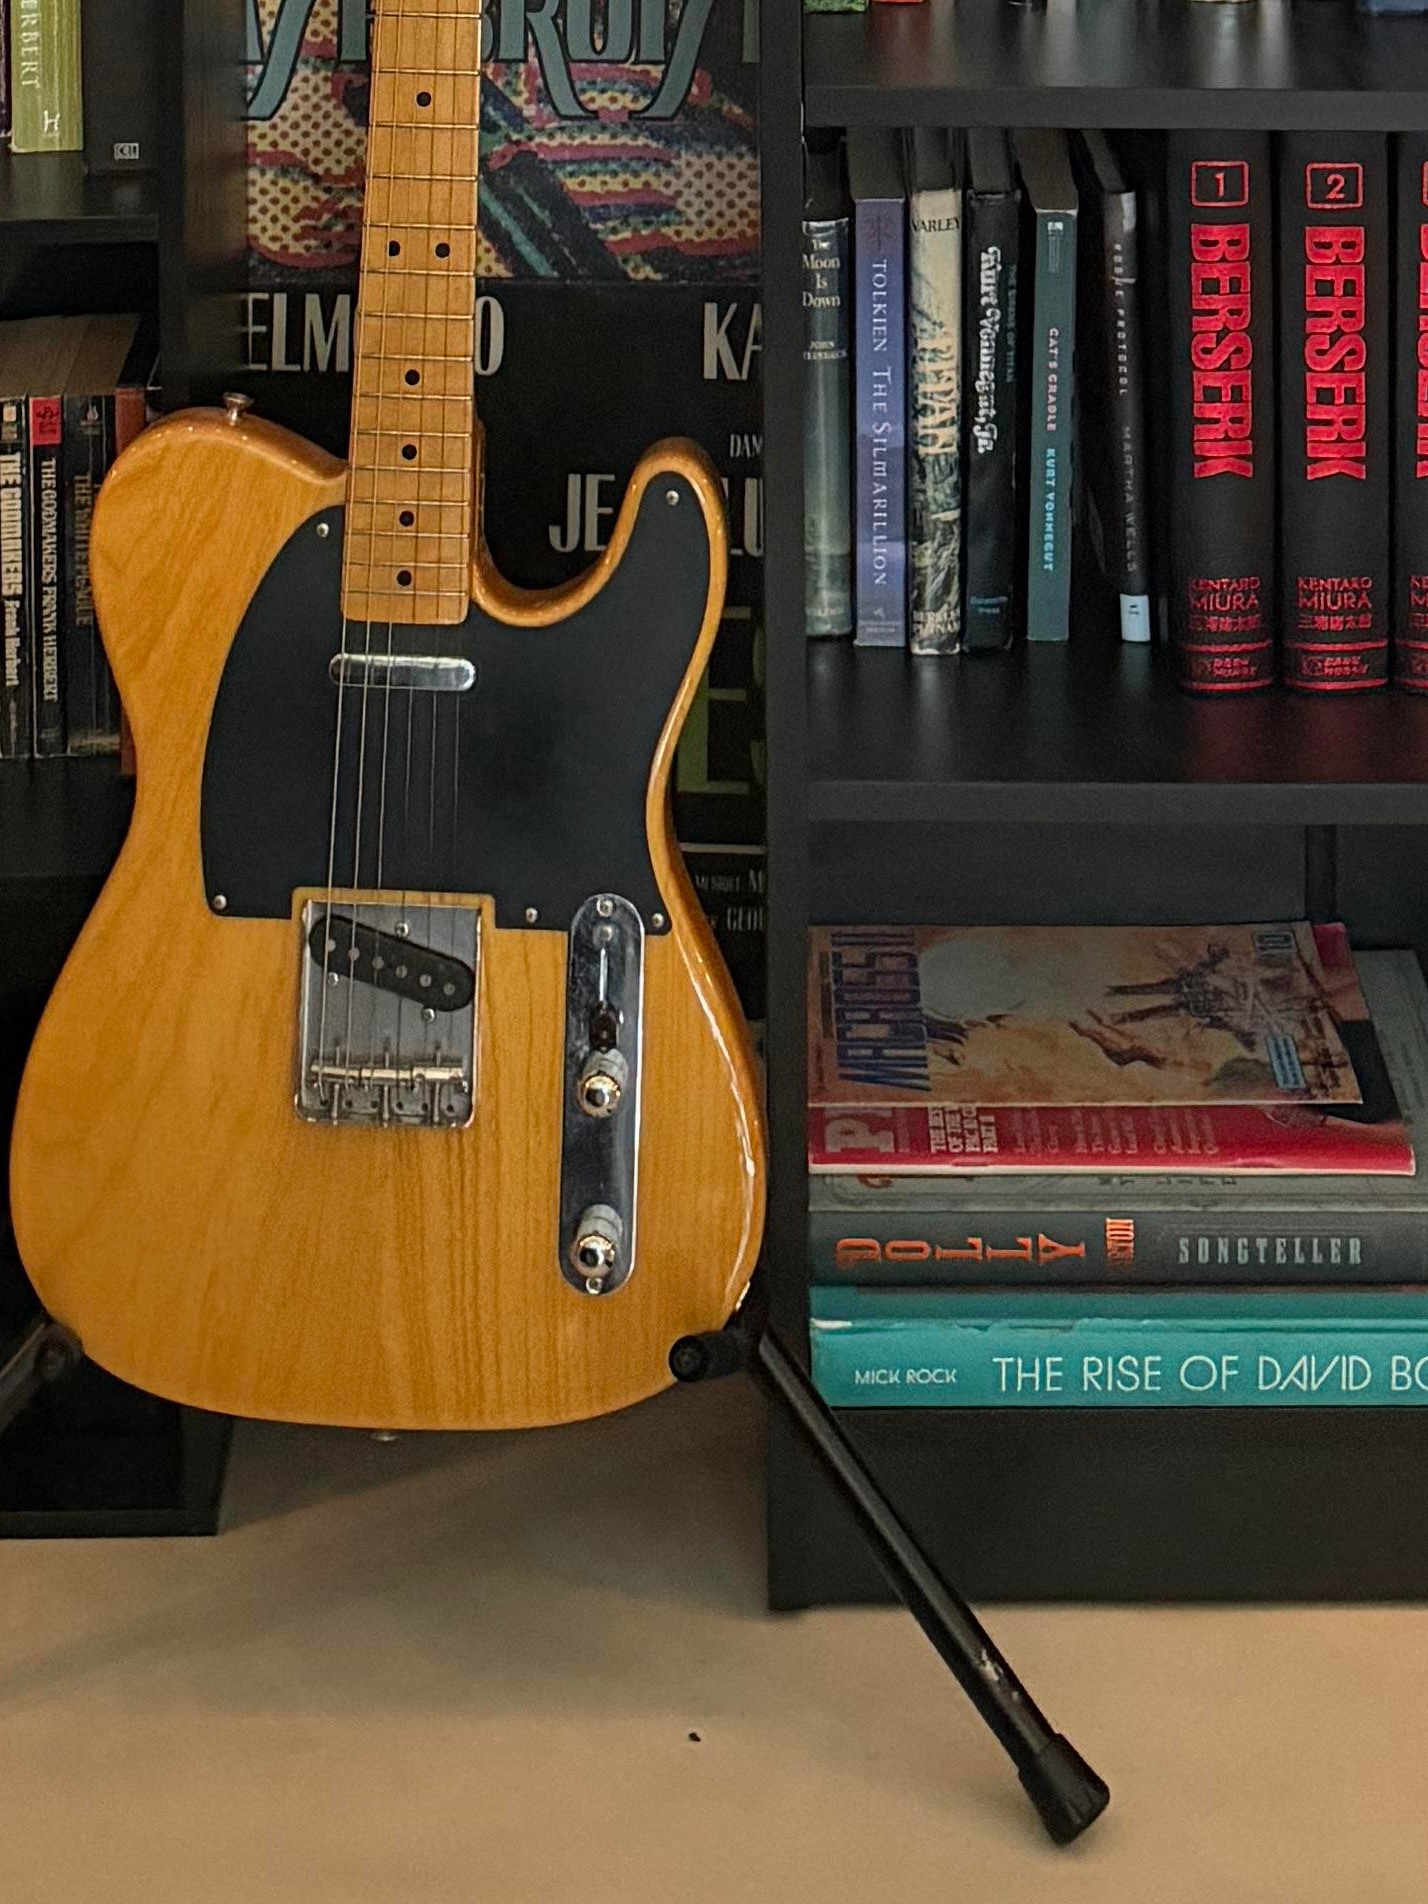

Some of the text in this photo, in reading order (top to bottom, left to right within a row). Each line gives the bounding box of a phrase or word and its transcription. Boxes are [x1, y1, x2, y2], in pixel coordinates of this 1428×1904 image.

[1213, 171, 1228, 198] 1
[1190, 223, 1253, 478] BERSERK
[1303, 225, 1366, 480] BERSERK
[872, 420, 889, 587] SILMARILLION
[1188, 590, 1259, 611] MIURA
[1177, 1236, 1364, 1266] SONGTELLER
[854, 1369, 958, 1387] MICK ROCK
[993, 1356, 1066, 1393] THE
[1081, 1356, 1163, 1391] RISE
[1179, 1356, 1240, 1391] OF
[1257, 1356, 1372, 1391] DAVID
